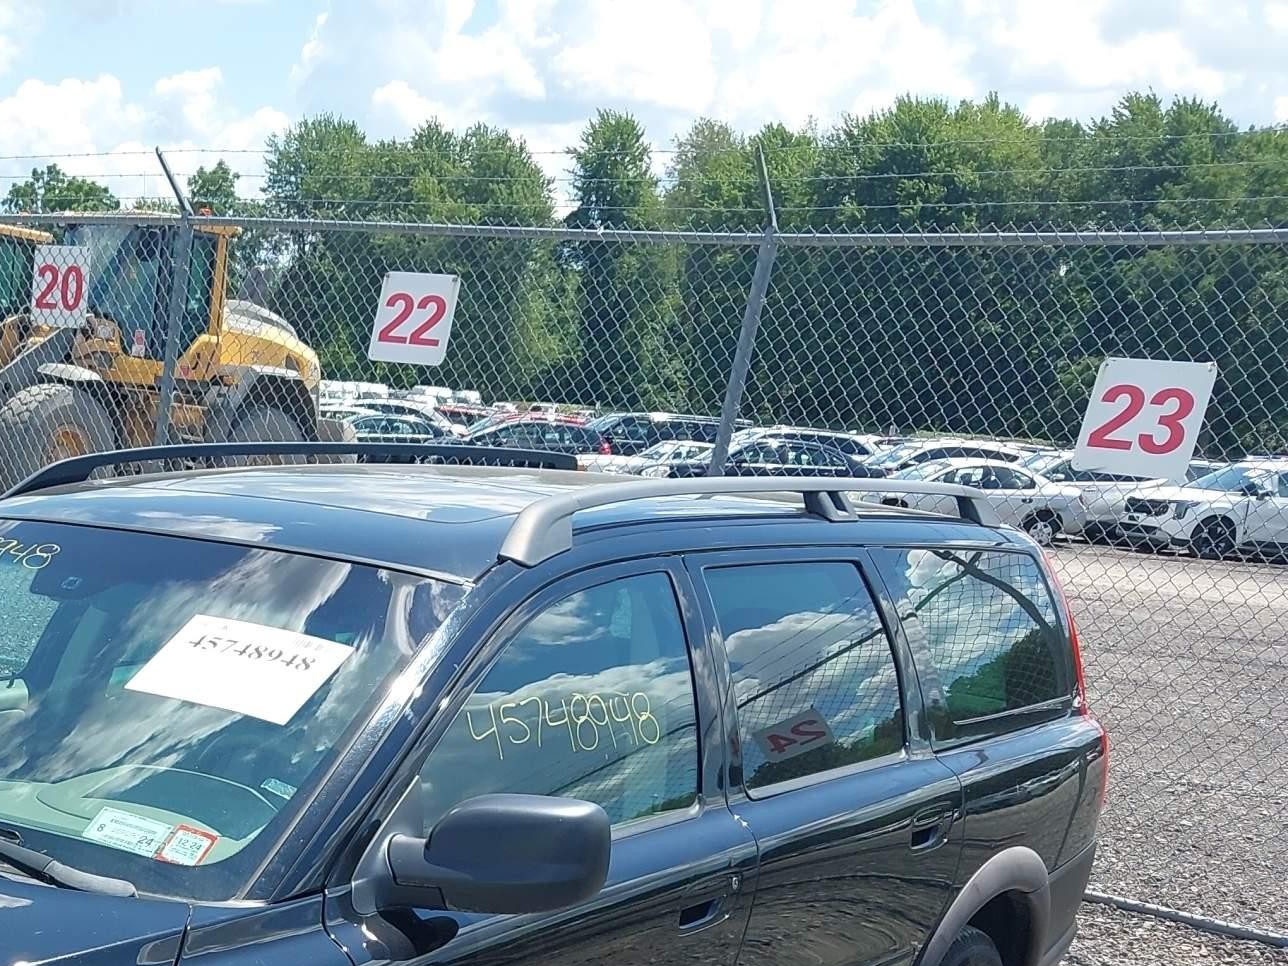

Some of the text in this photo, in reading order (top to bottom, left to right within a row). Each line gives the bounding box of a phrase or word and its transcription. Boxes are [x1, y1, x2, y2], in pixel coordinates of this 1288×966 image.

[35, 263, 84, 312] 20
[377, 292, 447, 347] 22
[1086, 384, 1195, 455] 23
[187, 633, 316, 671] 45748948
[466, 691, 661, 760] 45748948
[96, 823, 106, 833] 8
[137, 835, 154, 848] 24
